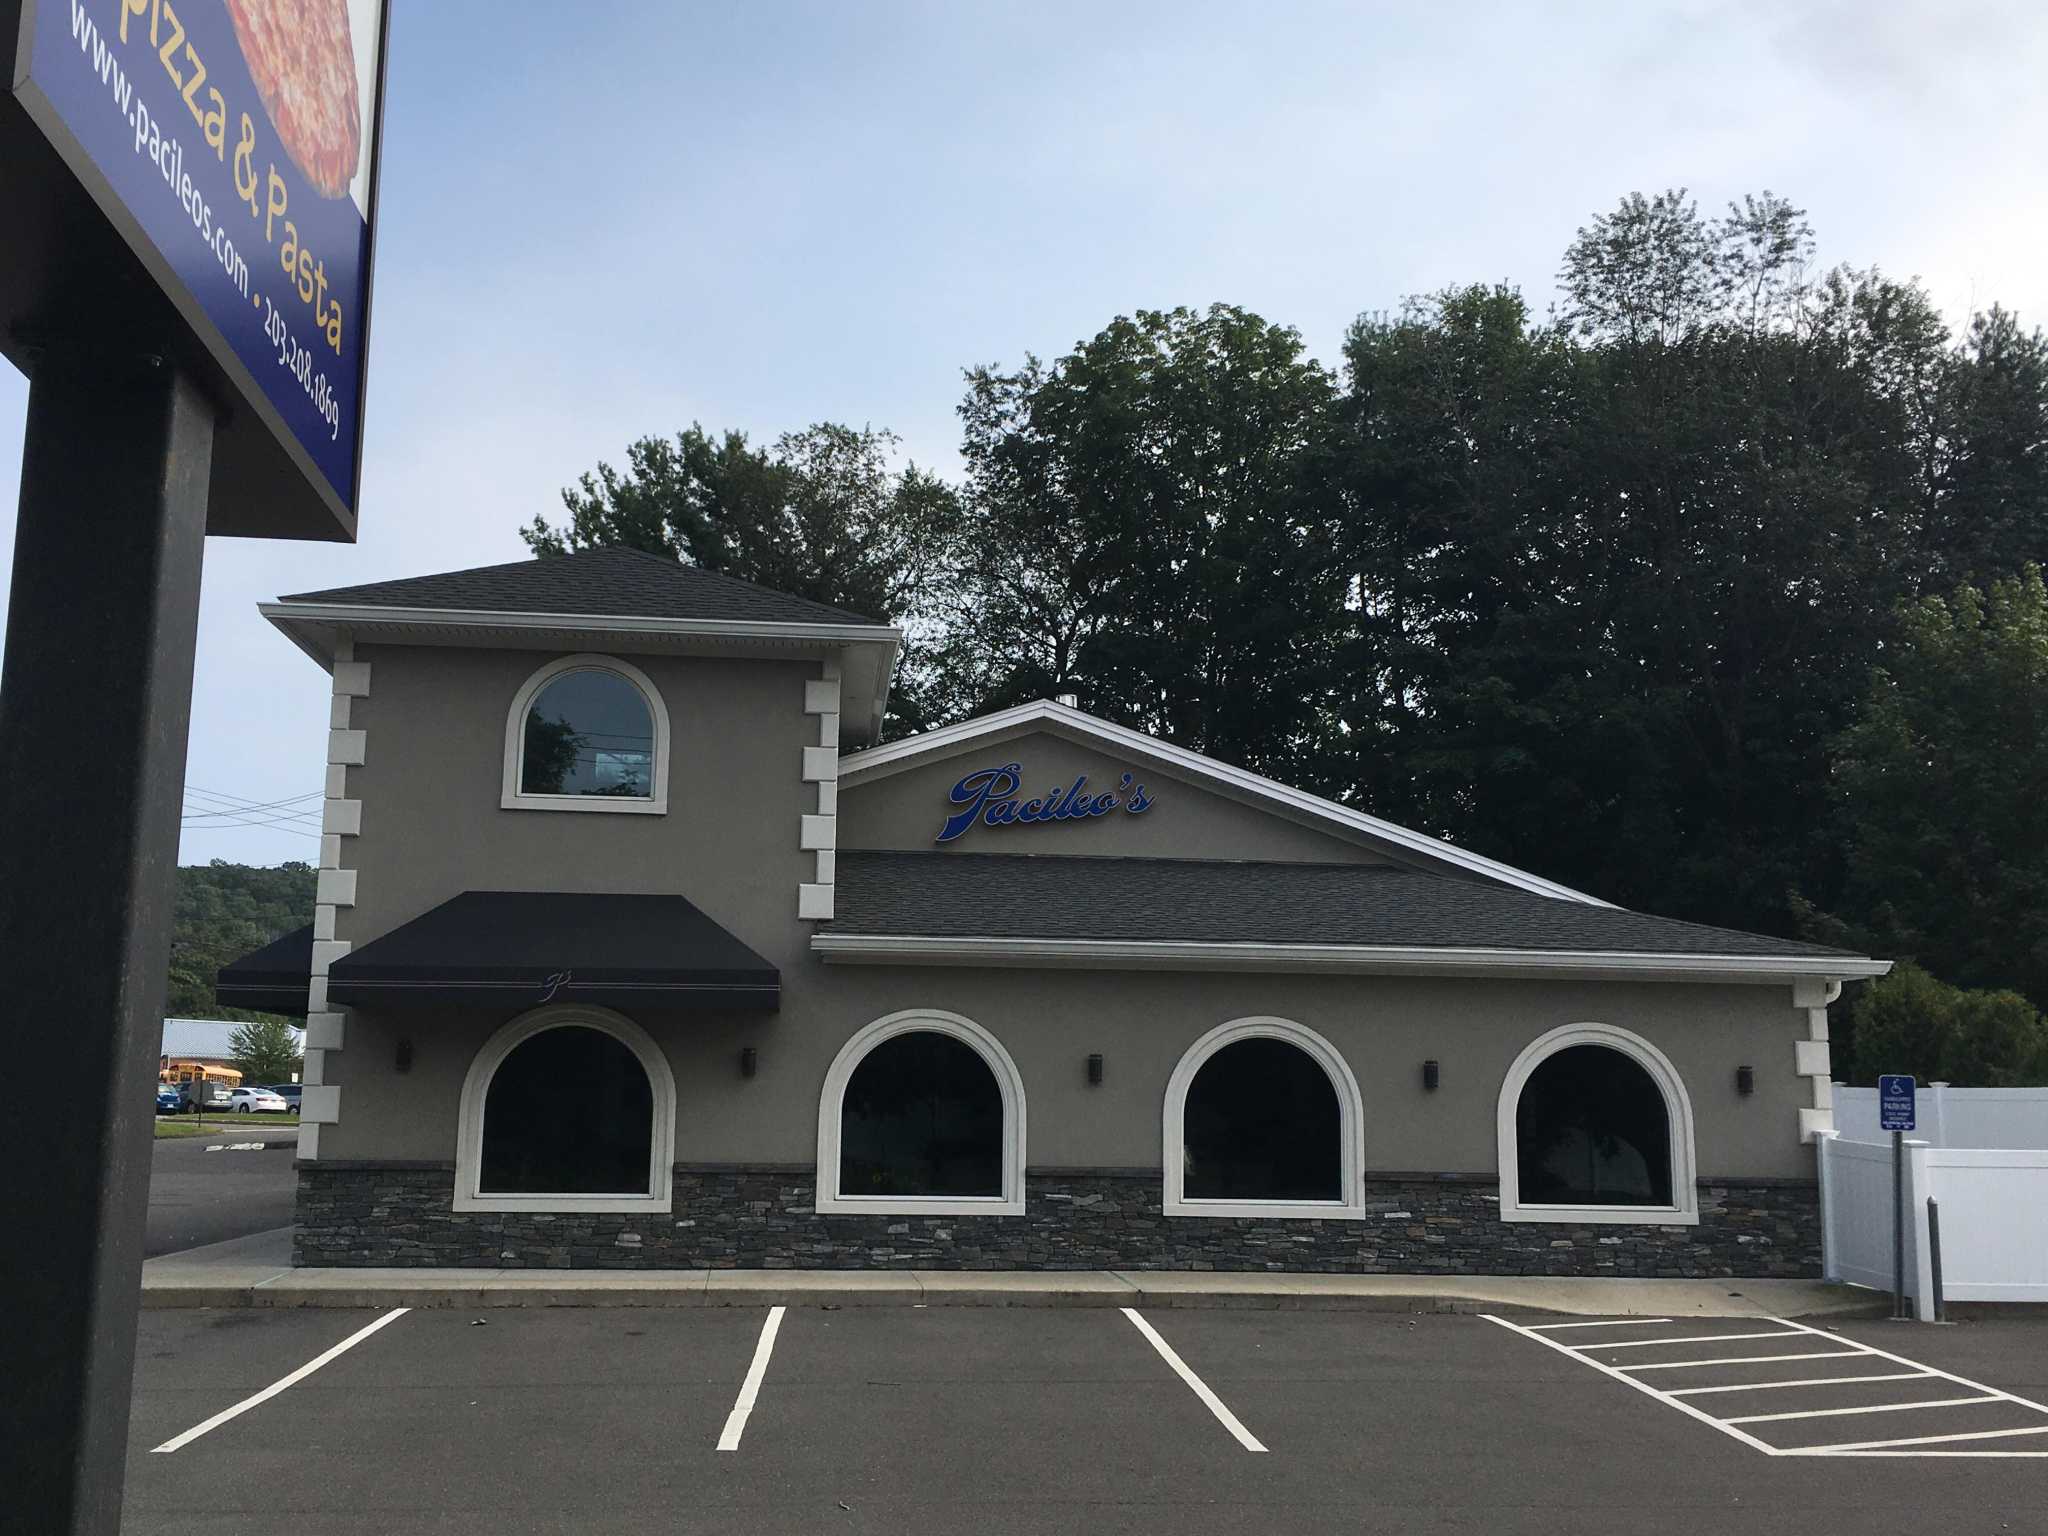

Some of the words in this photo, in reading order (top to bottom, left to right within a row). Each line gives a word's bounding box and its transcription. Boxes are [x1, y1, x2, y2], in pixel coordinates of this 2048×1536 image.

[71, 0, 249, 299] www.pacileos.com
[264, 295, 339, 441] 203.208.1869
[233, 111, 259, 218] &
[265, 162, 342, 355] Pasta
[936, 761, 1156, 842] Pacileo's
